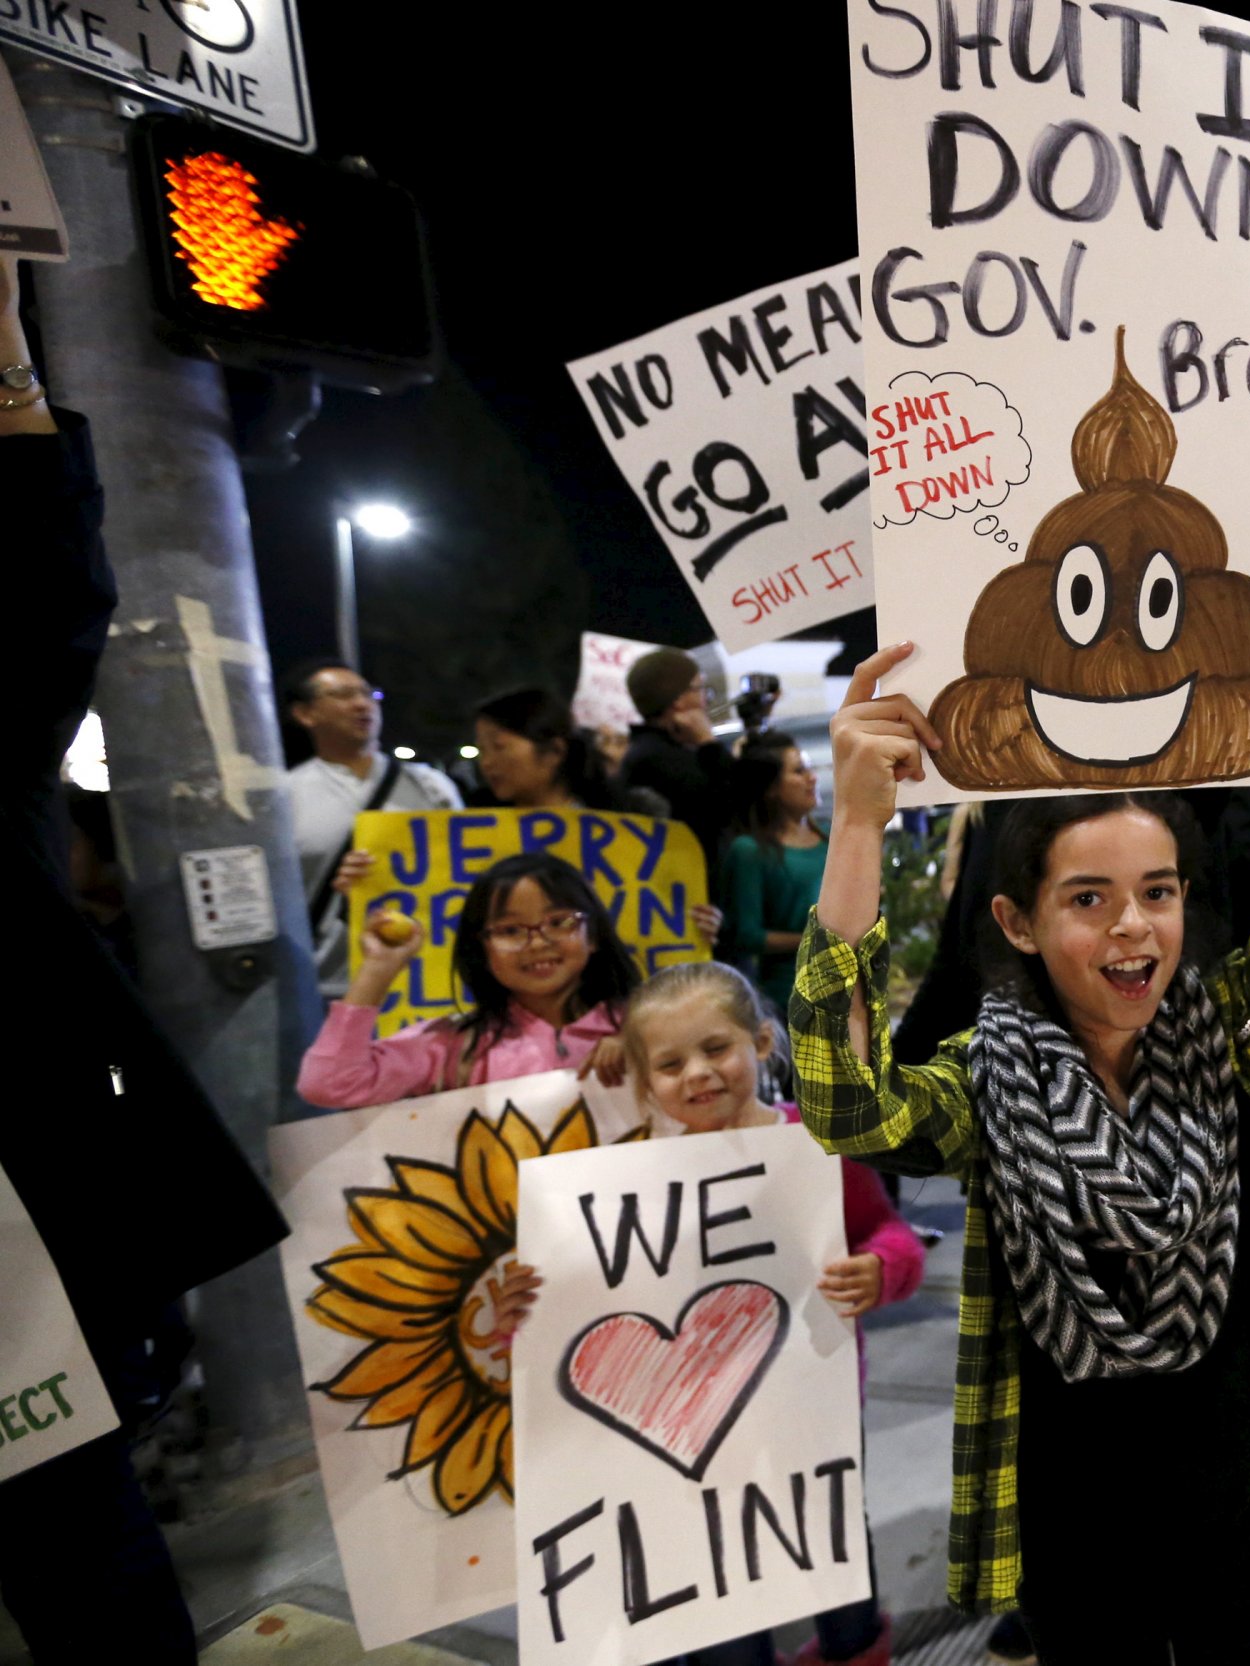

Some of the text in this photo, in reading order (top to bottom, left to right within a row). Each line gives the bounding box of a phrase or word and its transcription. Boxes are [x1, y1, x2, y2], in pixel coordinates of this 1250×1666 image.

[0, 0, 112, 58] IKE
[138, 33, 265, 117] LANE
[861, 0, 1169, 112] SHUT
[871, 238, 1097, 349] GOV.
[586, 353, 673, 440] NO
[871, 391, 951, 440] SHUT
[869, 416, 995, 476] IT ALL
[895, 455, 995, 513] DOWN
[643, 440, 770, 541] GO
[731, 540, 866, 626] SHUT IT
[389, 811, 668, 887] JERRY
[578, 1163, 777, 1289] WE
[0, 1371, 74, 1448] ECT
[532, 1457, 857, 1643] FLINT
